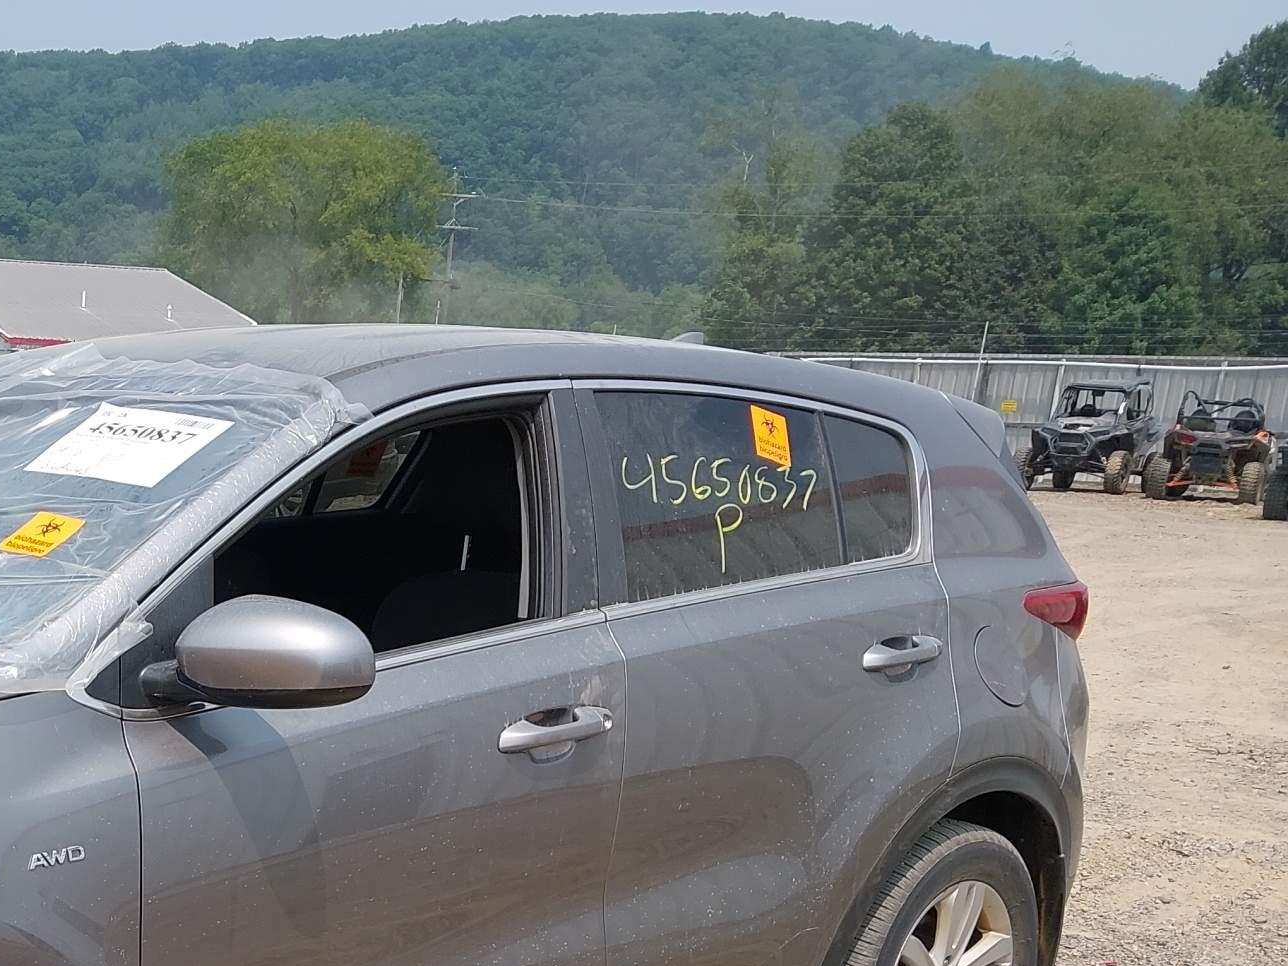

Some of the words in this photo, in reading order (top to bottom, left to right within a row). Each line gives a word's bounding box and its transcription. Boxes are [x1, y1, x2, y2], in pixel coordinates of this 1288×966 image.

[89, 421, 198, 445] 45650837
[621, 453, 817, 512] 45650837
[714, 503, 744, 574] P
[27, 845, 85, 870] AWD
